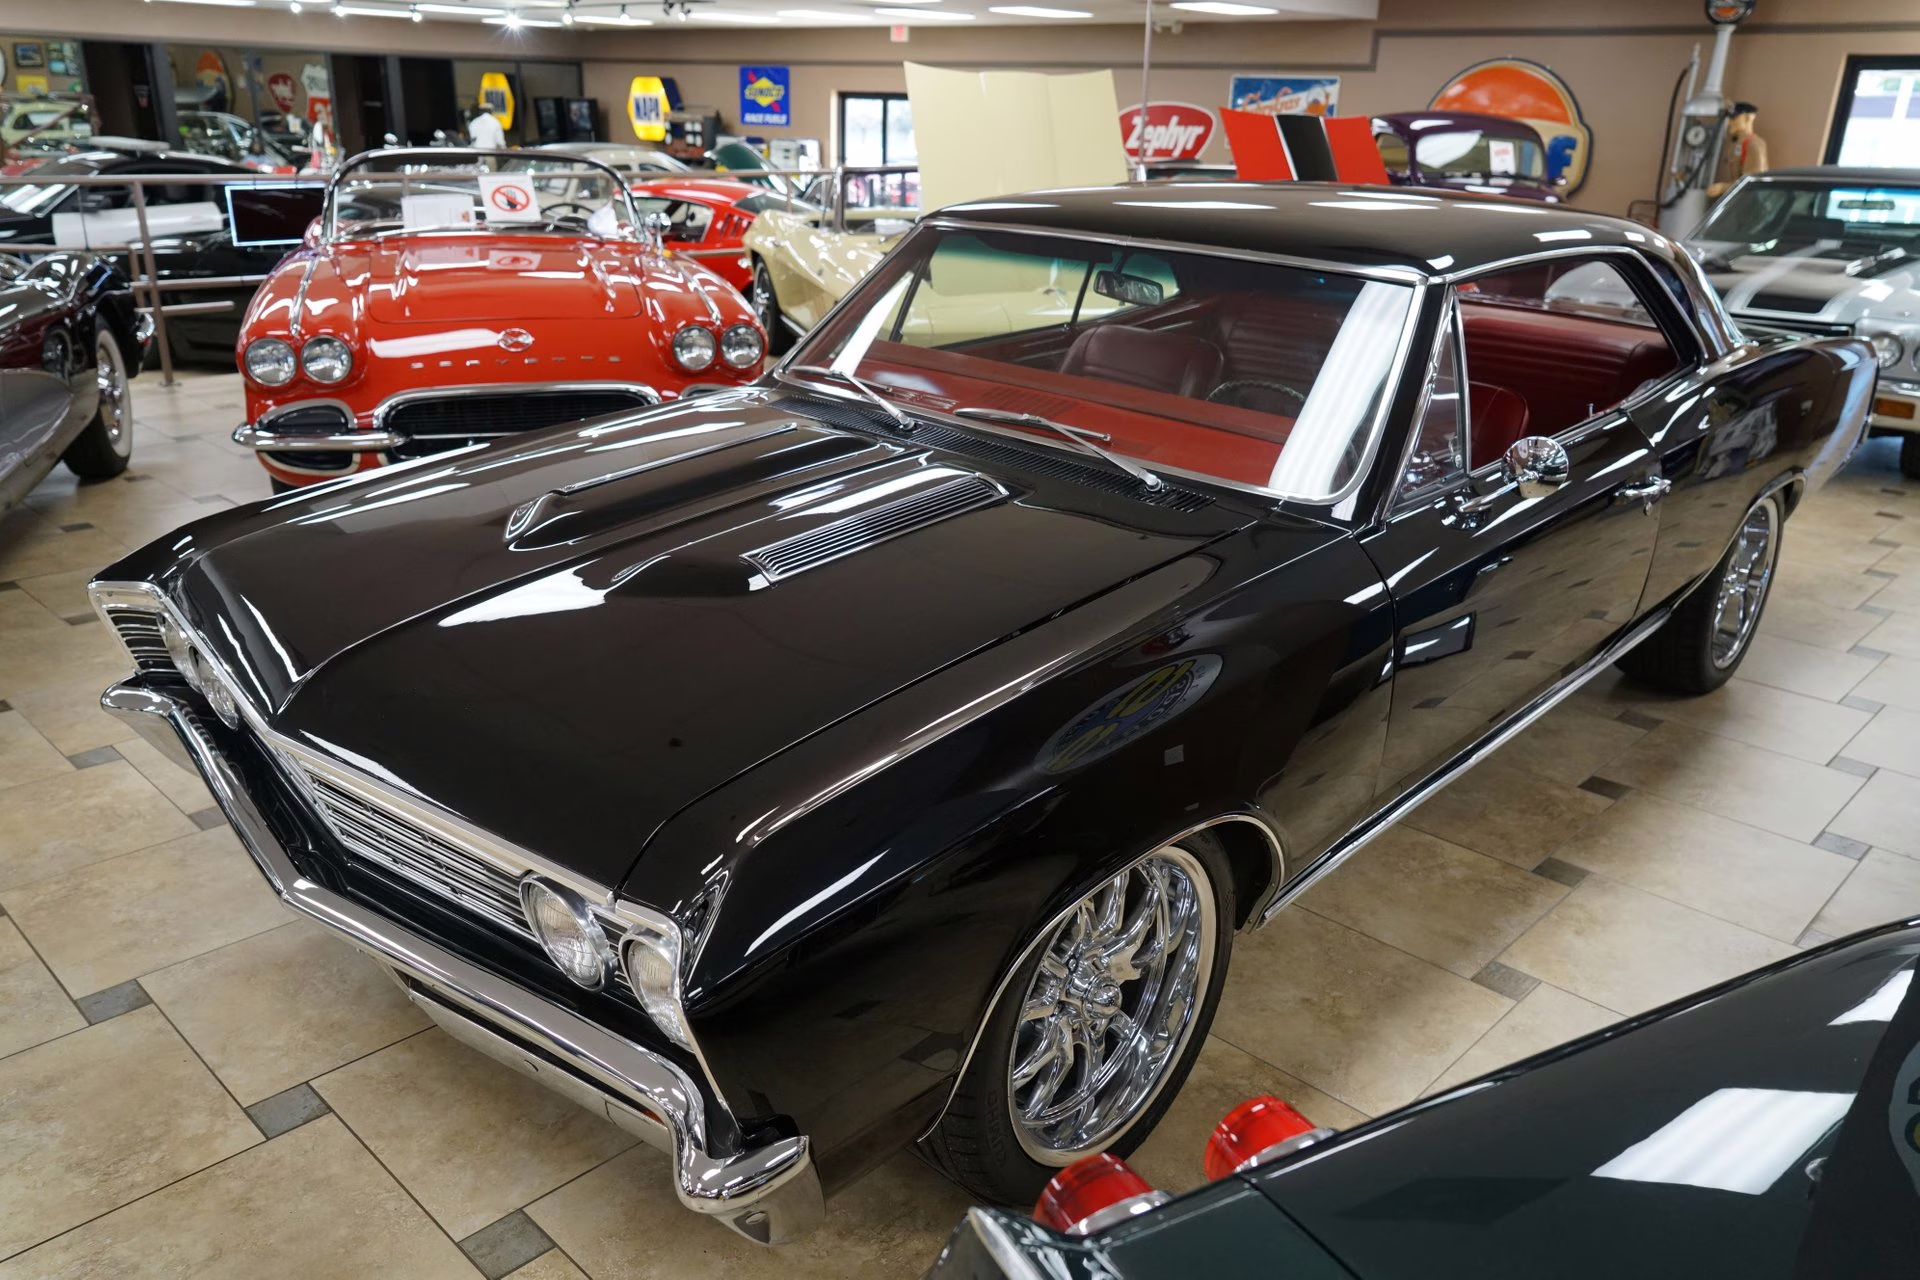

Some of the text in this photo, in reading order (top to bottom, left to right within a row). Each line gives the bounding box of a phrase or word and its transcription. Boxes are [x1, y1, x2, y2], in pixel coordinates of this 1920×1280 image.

[745, 85, 785, 99] SUNOCO
[634, 96, 660, 121] NAPA
[1125, 115, 1206, 158] Zephyr
